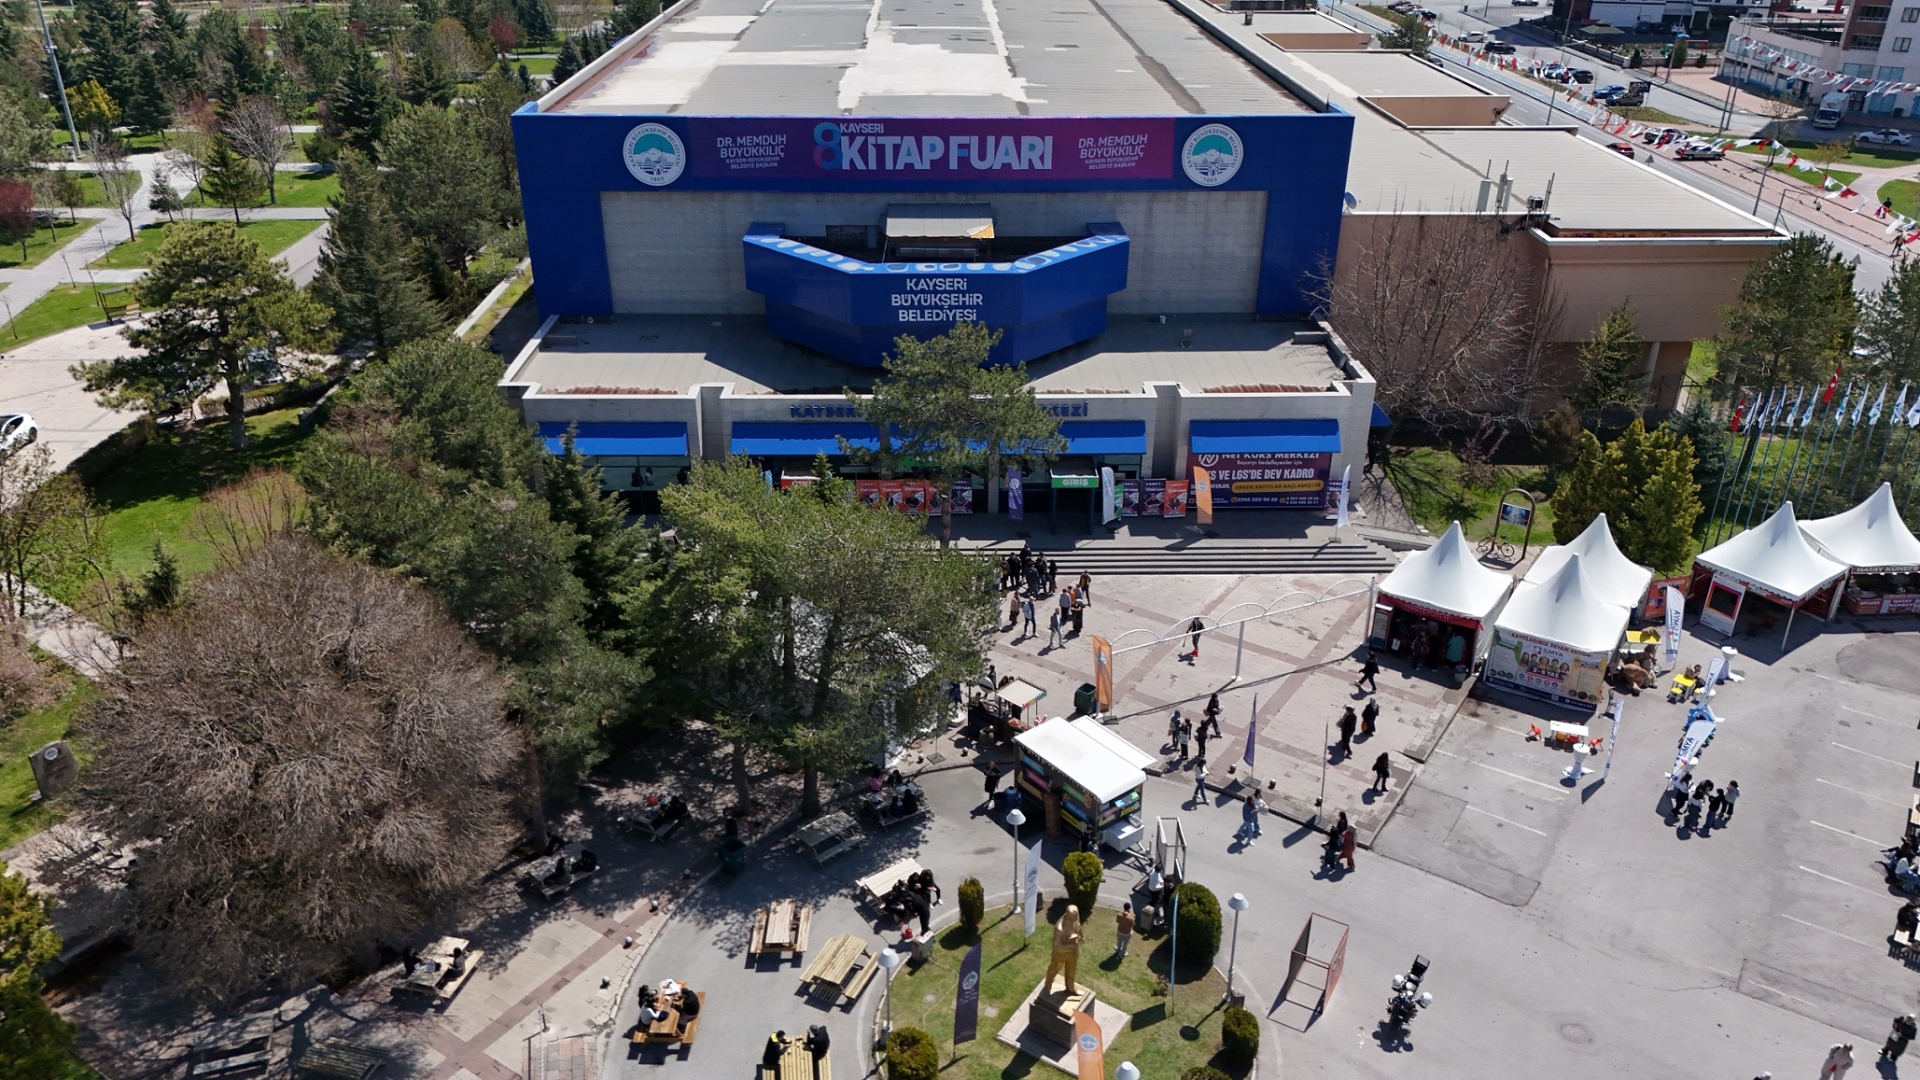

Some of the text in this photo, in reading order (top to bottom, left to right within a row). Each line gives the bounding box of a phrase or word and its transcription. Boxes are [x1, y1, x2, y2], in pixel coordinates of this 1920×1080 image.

[840, 123, 884, 134] KAYSERİ
[717, 134, 786, 148] DR. MEMDUH
[1078, 134, 1148, 148] DR. MEMDUH
[720, 145, 785, 158] BÜYÜKKILIÇ
[840, 136, 1053, 170] KİTAP FUARI
[1080, 145, 1145, 158] BÜYÜKKILIÇ
[906, 278, 967, 290] KAYSERİ
[891, 294, 983, 308] BÜYÜKŞEHİR
[899, 309, 976, 321] BELEDİYESİ
[790, 405, 863, 418] KAYSER
[1219, 470, 1230, 480] VE
[1232, 470, 1262, 480] LGS'DE
[1264, 469, 1282, 479] DEV
[1283, 468, 1314, 479] KADRO
